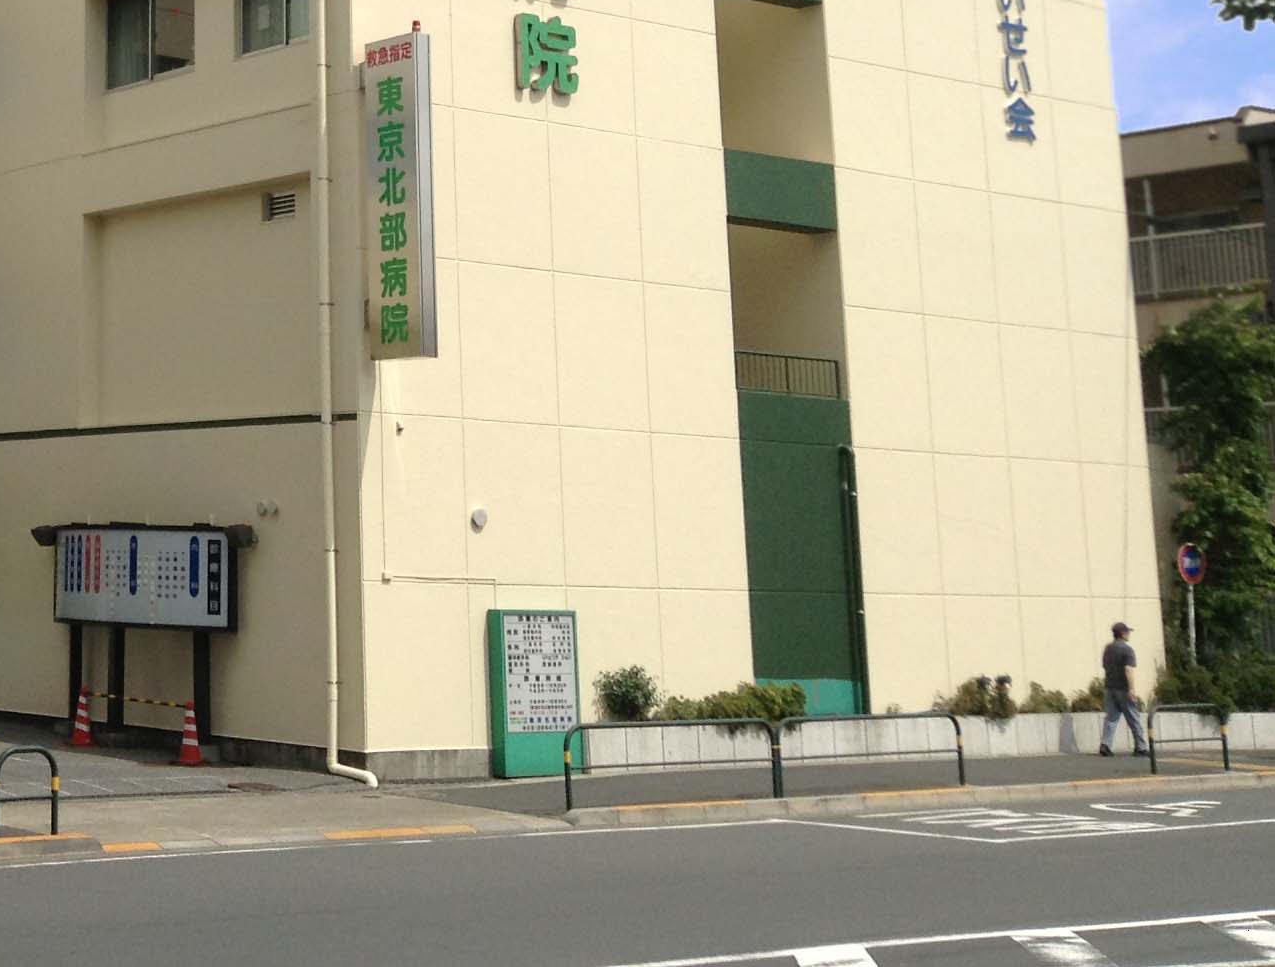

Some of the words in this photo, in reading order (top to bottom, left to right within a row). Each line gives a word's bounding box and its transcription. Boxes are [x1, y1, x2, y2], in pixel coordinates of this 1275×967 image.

[367, 42, 413, 67] 救急指定
[377, 76, 410, 345] 東京北部病院
